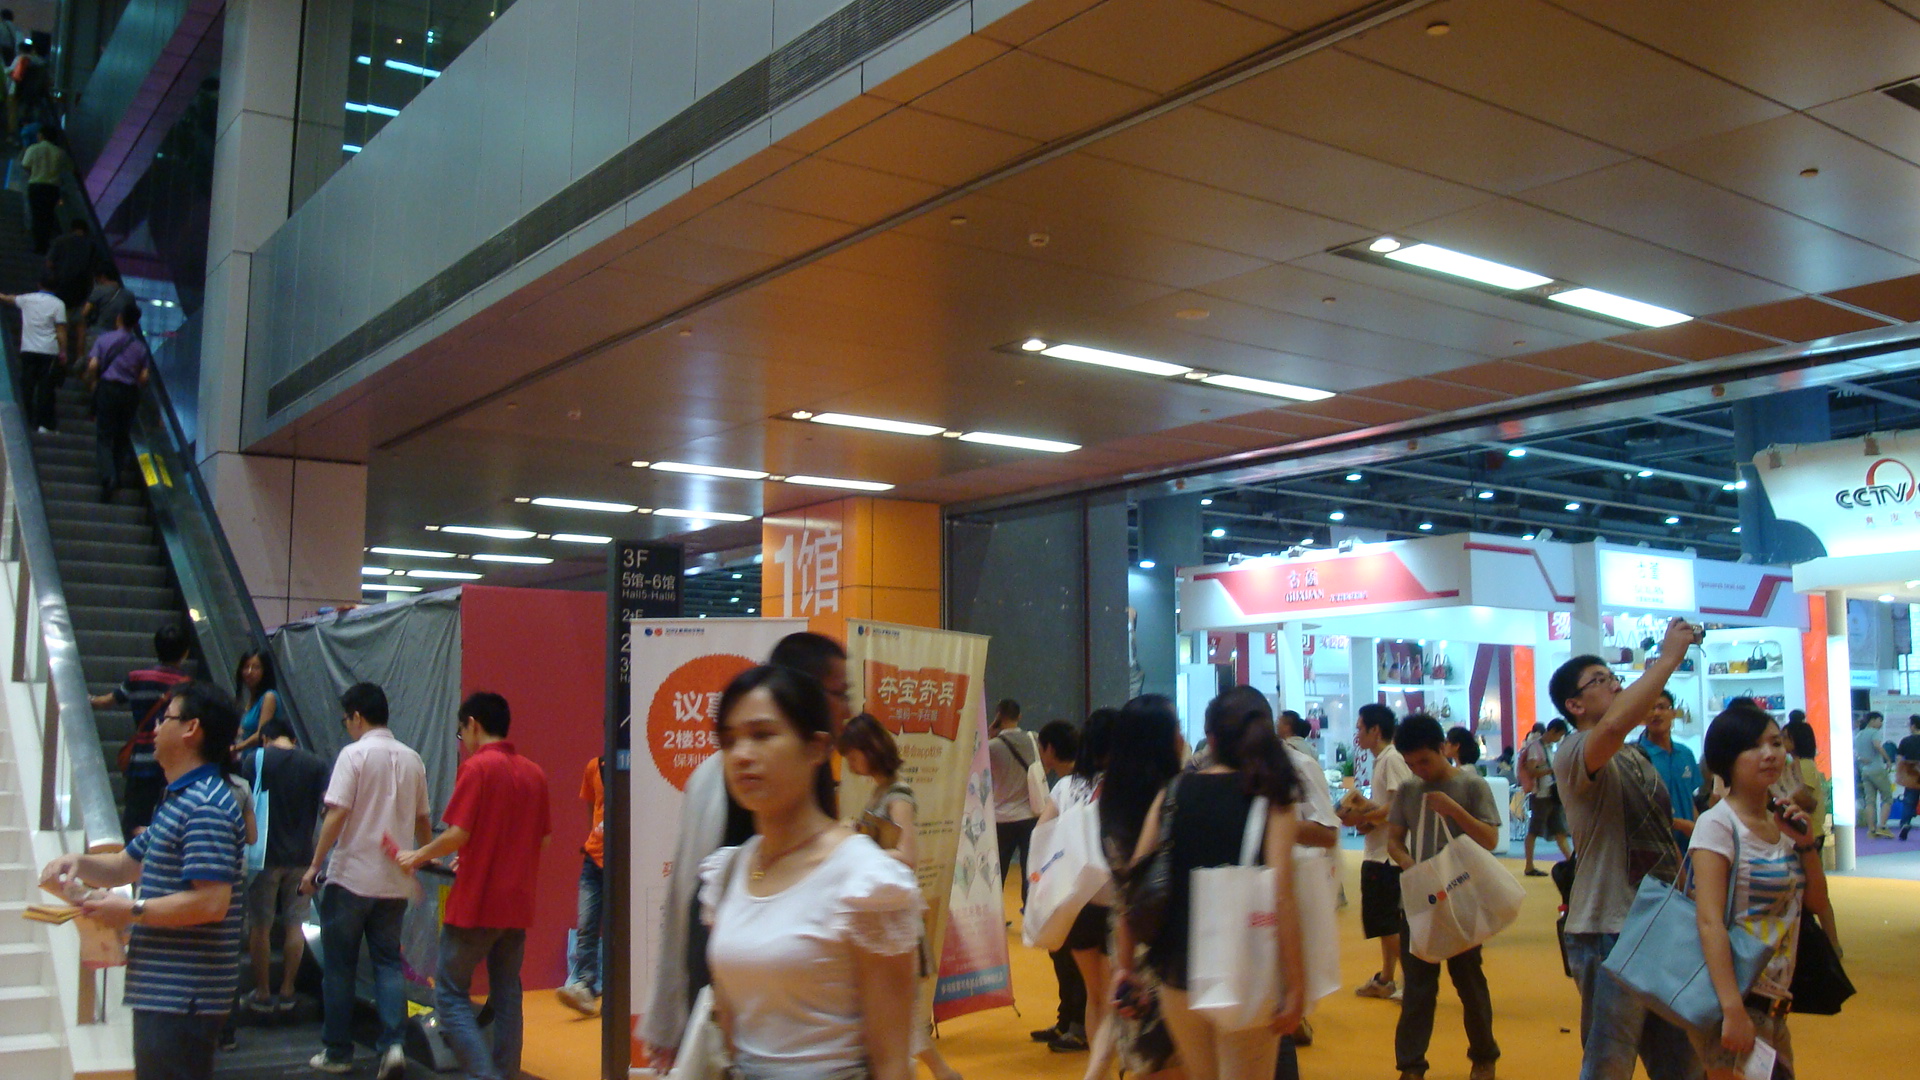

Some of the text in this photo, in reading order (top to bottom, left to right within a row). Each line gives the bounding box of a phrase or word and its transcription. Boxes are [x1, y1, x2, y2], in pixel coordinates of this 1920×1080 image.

[1836, 482, 1906, 509] CCTV
[623, 549, 649, 568] 3F
[775, 527, 842, 617] 1馆
[622, 572, 676, 590] 5馆-6馆
[878, 675, 955, 707] 夺宝奇兵
